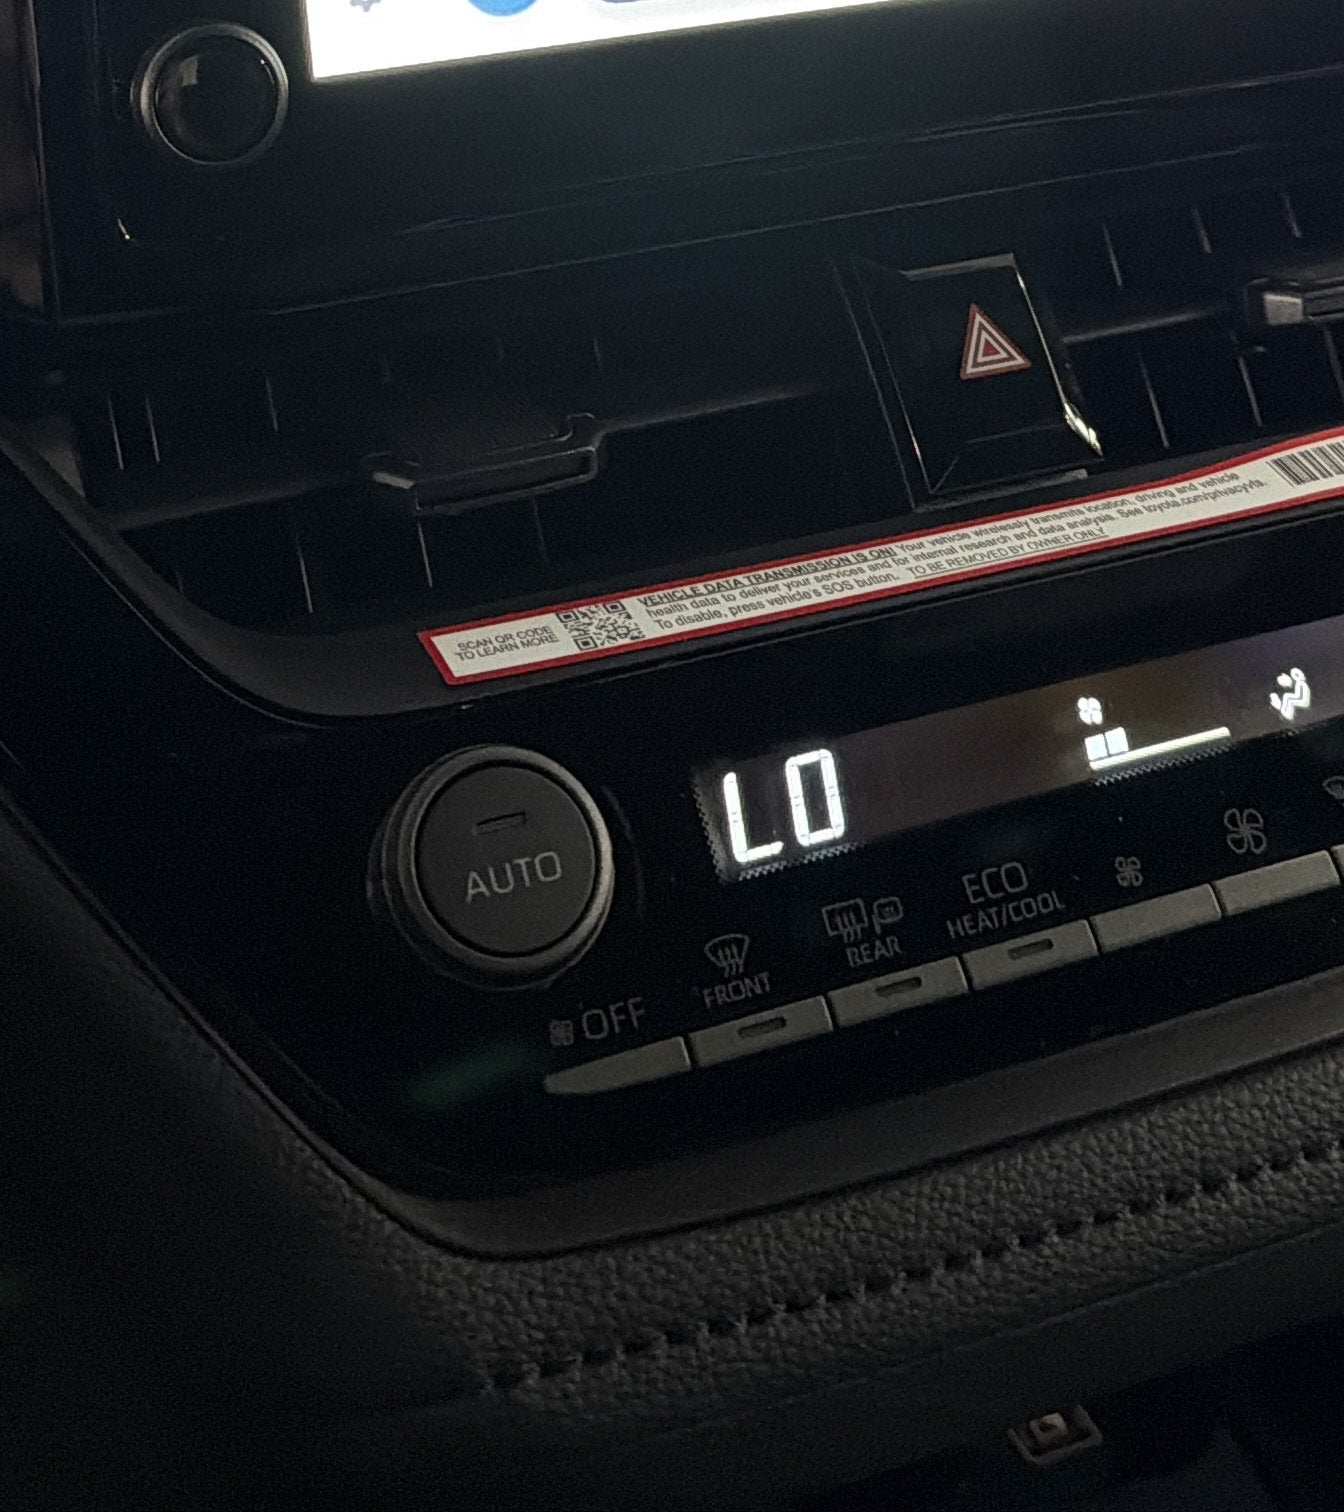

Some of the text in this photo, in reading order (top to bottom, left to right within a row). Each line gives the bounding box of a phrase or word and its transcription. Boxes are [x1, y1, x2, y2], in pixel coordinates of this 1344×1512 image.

[637, 586, 706, 607] VEHICLE
[706, 576, 746, 595] DATA
[745, 554, 851, 586] TRANSMISSION
[852, 552, 868, 565] IS
[869, 546, 897, 561] ON!
[896, 541, 926, 554] Your
[927, 530, 972, 547] vehicle
[972, 519, 1029, 539] wirelessly
[1030, 507, 1085, 526] transmits
[1134, 487, 1176, 505] driving
[1175, 482, 1198, 495] and
[1198, 472, 1240, 489] vehicle
[646, 601, 689, 619] health
[690, 595, 720, 609] data
[721, 592, 737, 603] to
[739, 583, 783, 600] deliver
[783, 579, 812, 594] your
[814, 567, 867, 585] services
[868, 558, 893, 572] and
[894, 555, 911, 568] for
[912, 546, 960, 563] internal
[959, 534, 1014, 556] research
[1014, 529, 1037, 542] and
[1038, 523, 1066, 537] data
[1118, 506, 1144, 519] See
[654, 527, 1107, 632] To disable, press vehicle's SOS button. TO BE REMOVED BY OWNER ONLY
[455, 634, 560, 661] TO LEARN MORE
[457, 637, 494, 652] SCAN
[516, 626, 554, 640] CODE
[464, 849, 565, 905] AUTO
[962, 860, 1028, 905] ECO
[945, 888, 1067, 941] HEAT/COOL
[844, 934, 904, 968] REAR
[702, 970, 773, 1009] FRONT
[581, 995, 648, 1041] OFF
